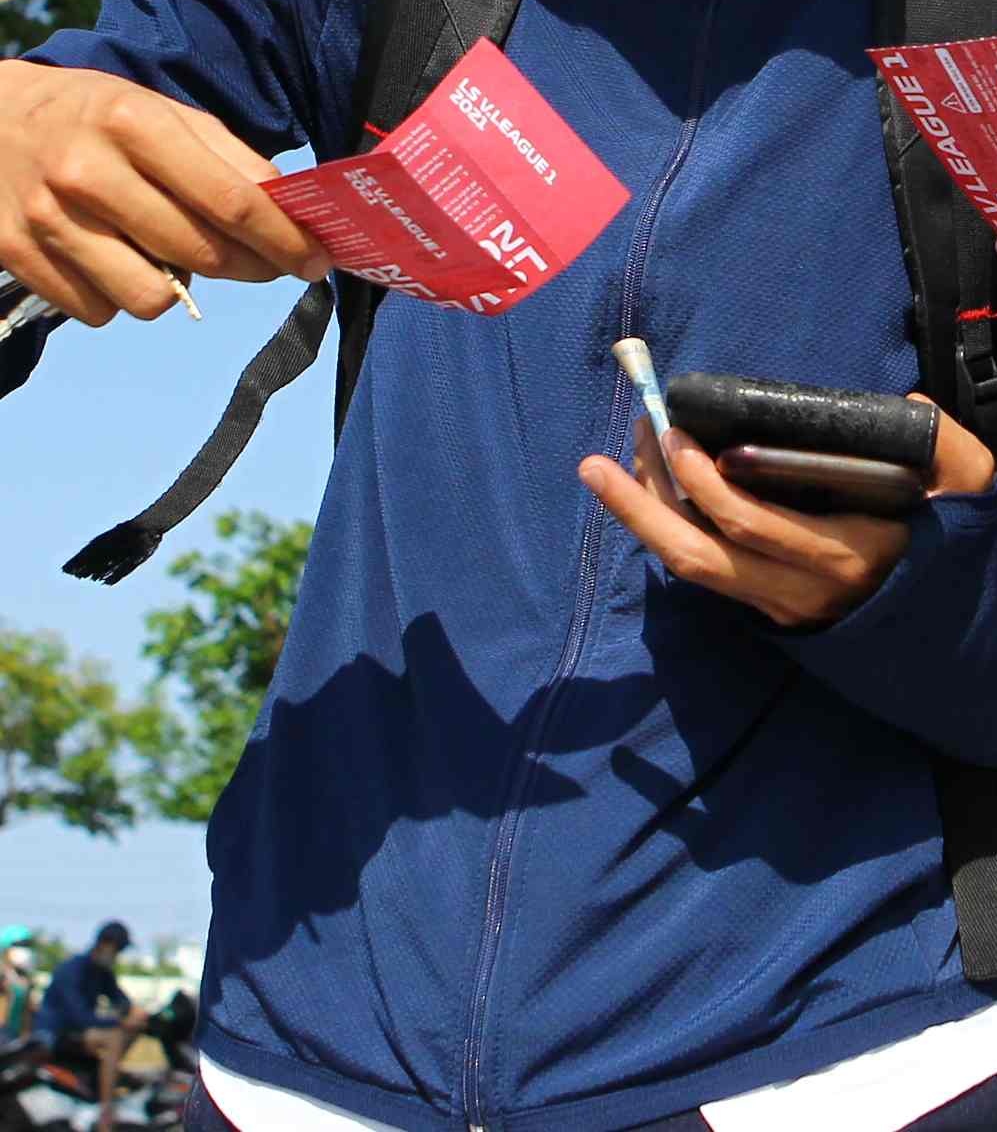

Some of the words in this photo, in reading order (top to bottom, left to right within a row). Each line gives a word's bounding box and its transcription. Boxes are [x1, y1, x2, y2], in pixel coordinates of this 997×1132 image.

[882, 52, 911, 70] 1
[448, 92, 492, 133] 2021
[457, 77, 482, 102] LS
[480, 96, 549, 177] V.LEAGUE
[543, 169, 560, 187] 1
